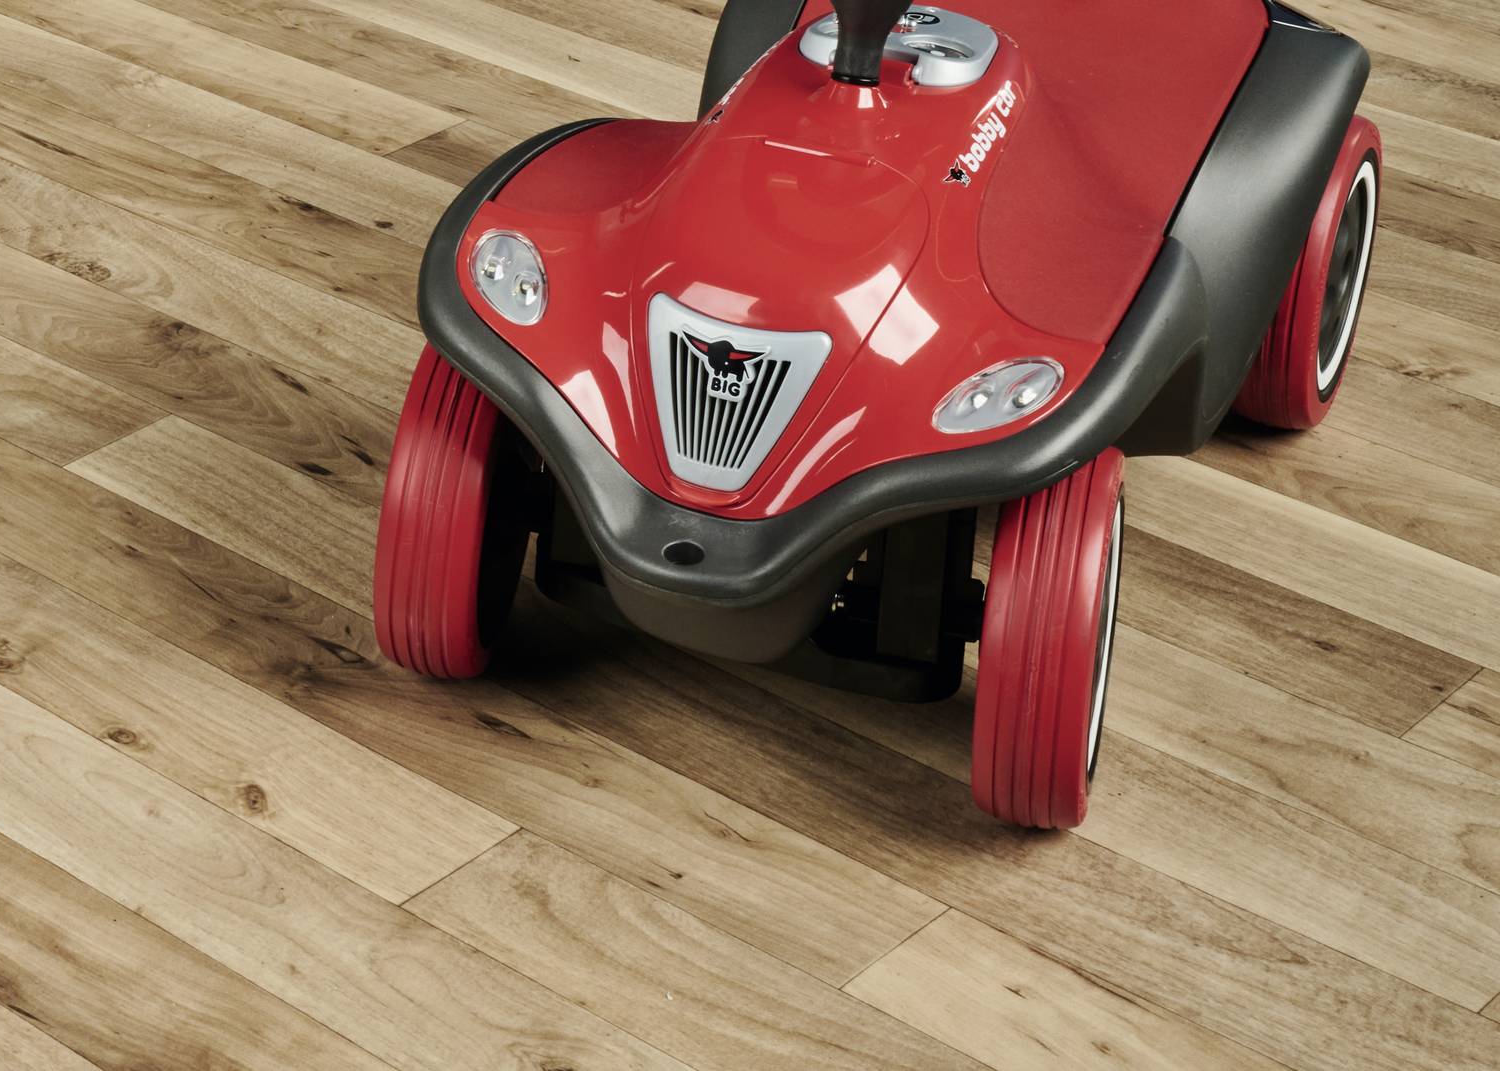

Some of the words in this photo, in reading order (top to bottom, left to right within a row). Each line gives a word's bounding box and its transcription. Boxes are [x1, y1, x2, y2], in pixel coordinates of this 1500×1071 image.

[959, 112, 1007, 172] bobby
[995, 80, 1017, 118] car
[711, 377, 741, 397] BIG
